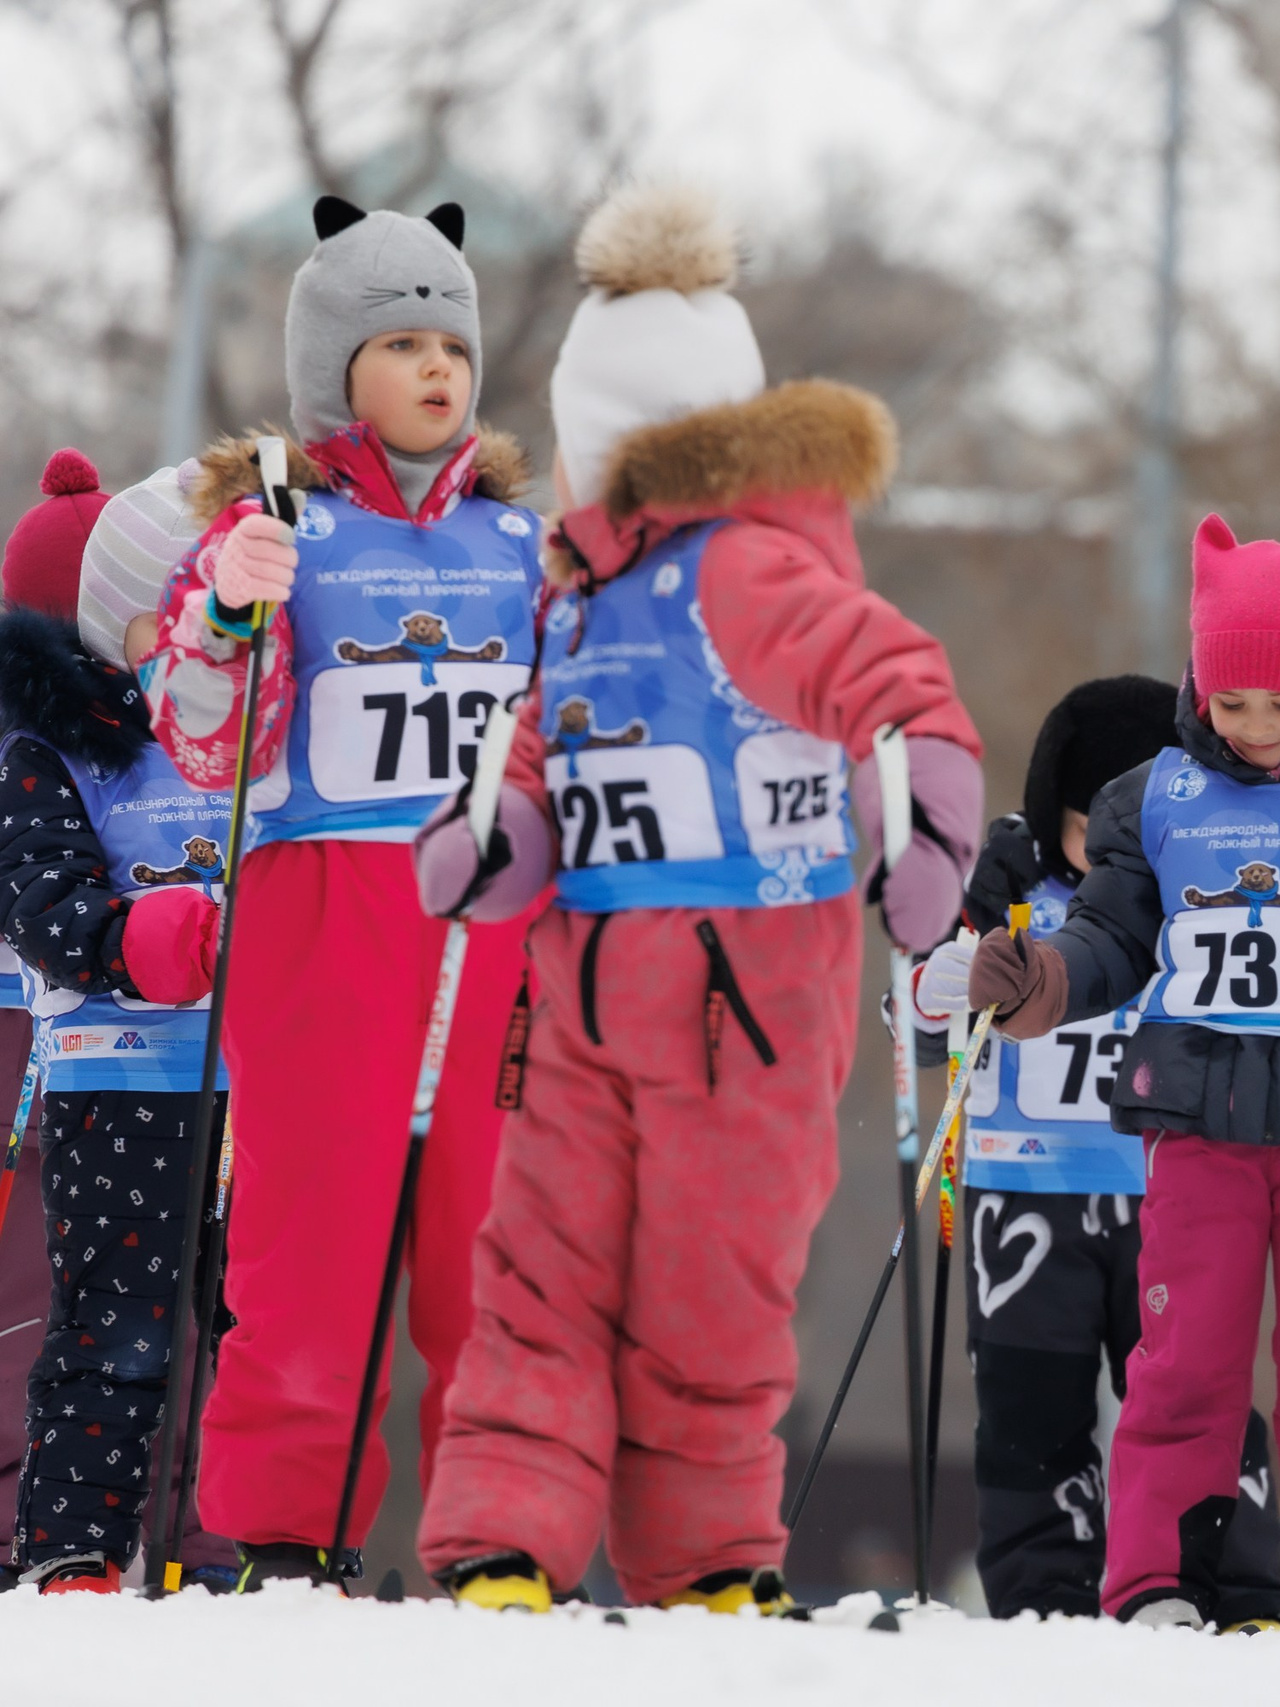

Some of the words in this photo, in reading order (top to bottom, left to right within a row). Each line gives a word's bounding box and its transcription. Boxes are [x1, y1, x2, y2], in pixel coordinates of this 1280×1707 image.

[763, 774, 827, 827] 725
[549, 780, 665, 870] 25
[1172, 822, 1279, 839] МЕЖДУНАРОДНЫЙ
[1207, 836, 1261, 850] ЛЫЖНЫЙ
[61, 1033, 82, 1053] ЦСП
